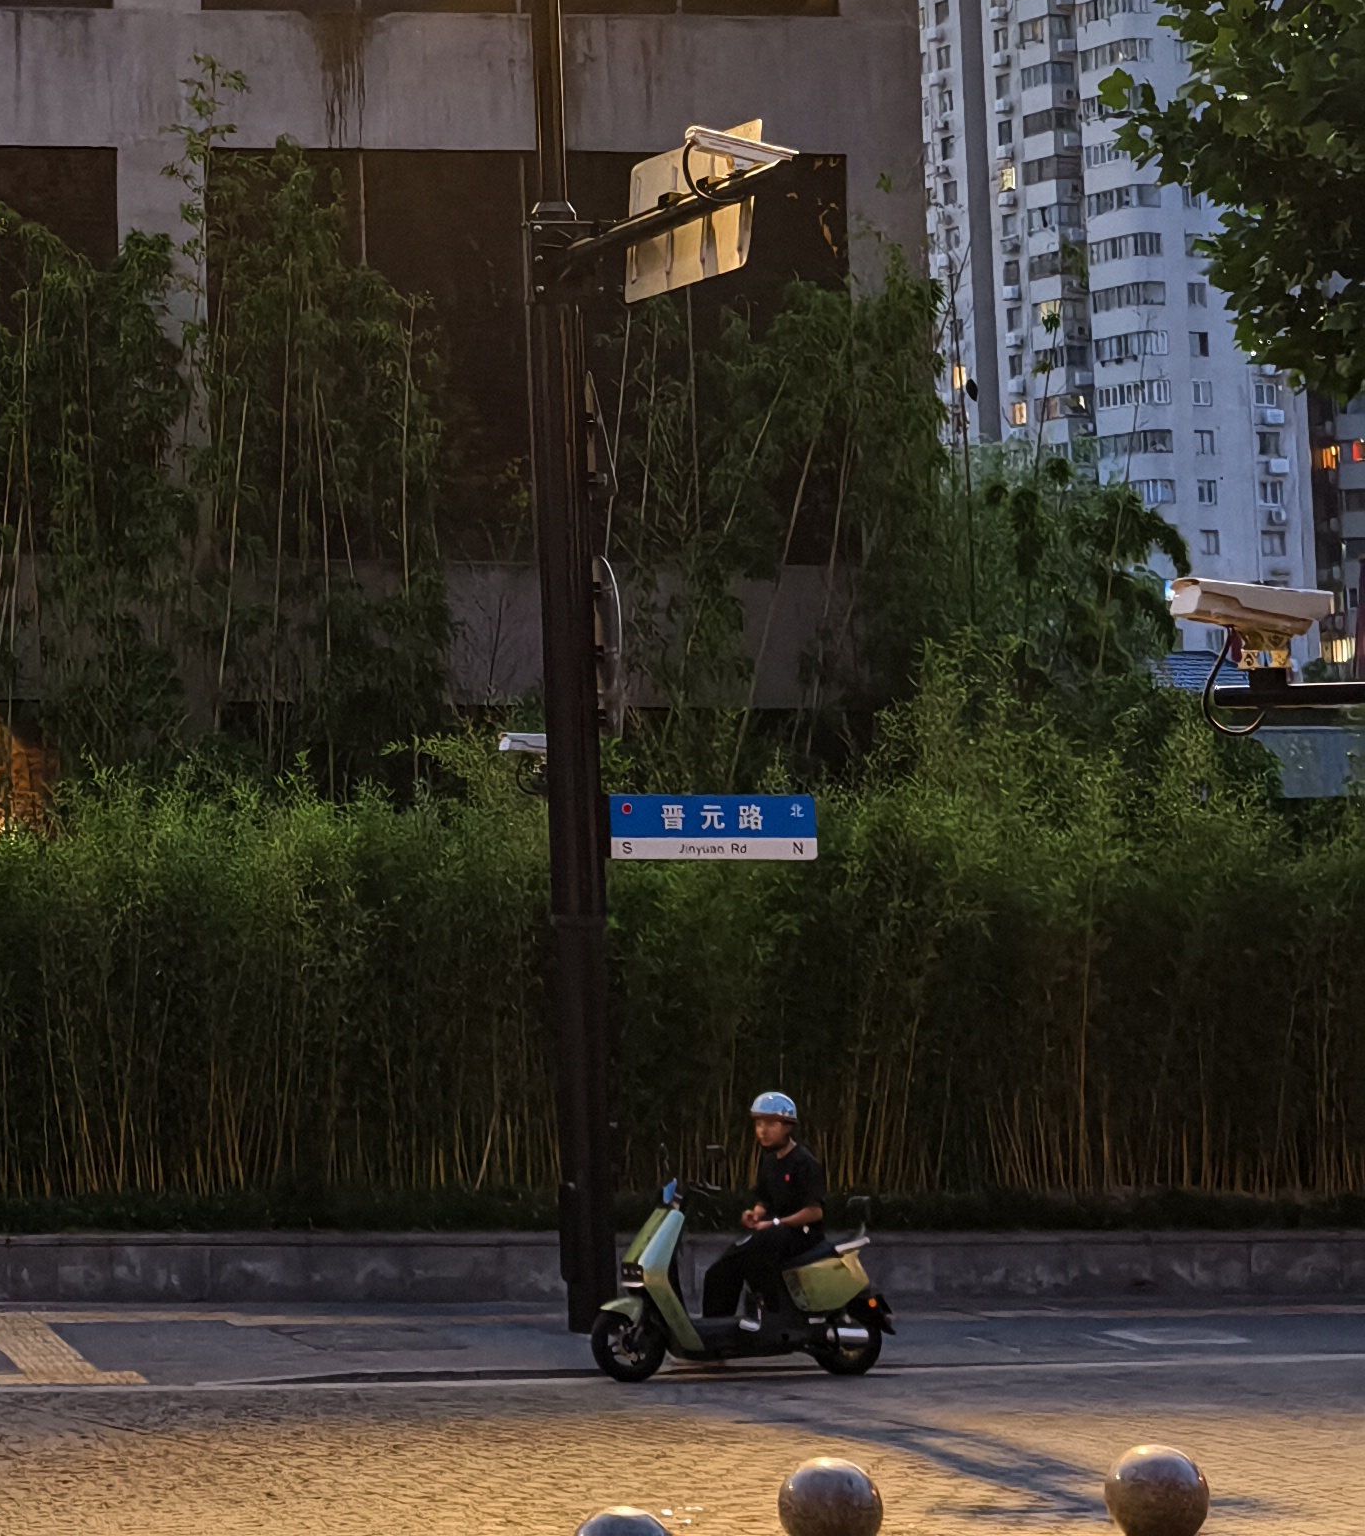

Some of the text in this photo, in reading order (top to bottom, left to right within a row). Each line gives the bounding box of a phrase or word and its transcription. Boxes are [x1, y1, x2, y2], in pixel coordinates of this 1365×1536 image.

[660, 803, 804, 831] 晋元路 北
[622, 841, 804, 856] S Jinyuan Rd N
